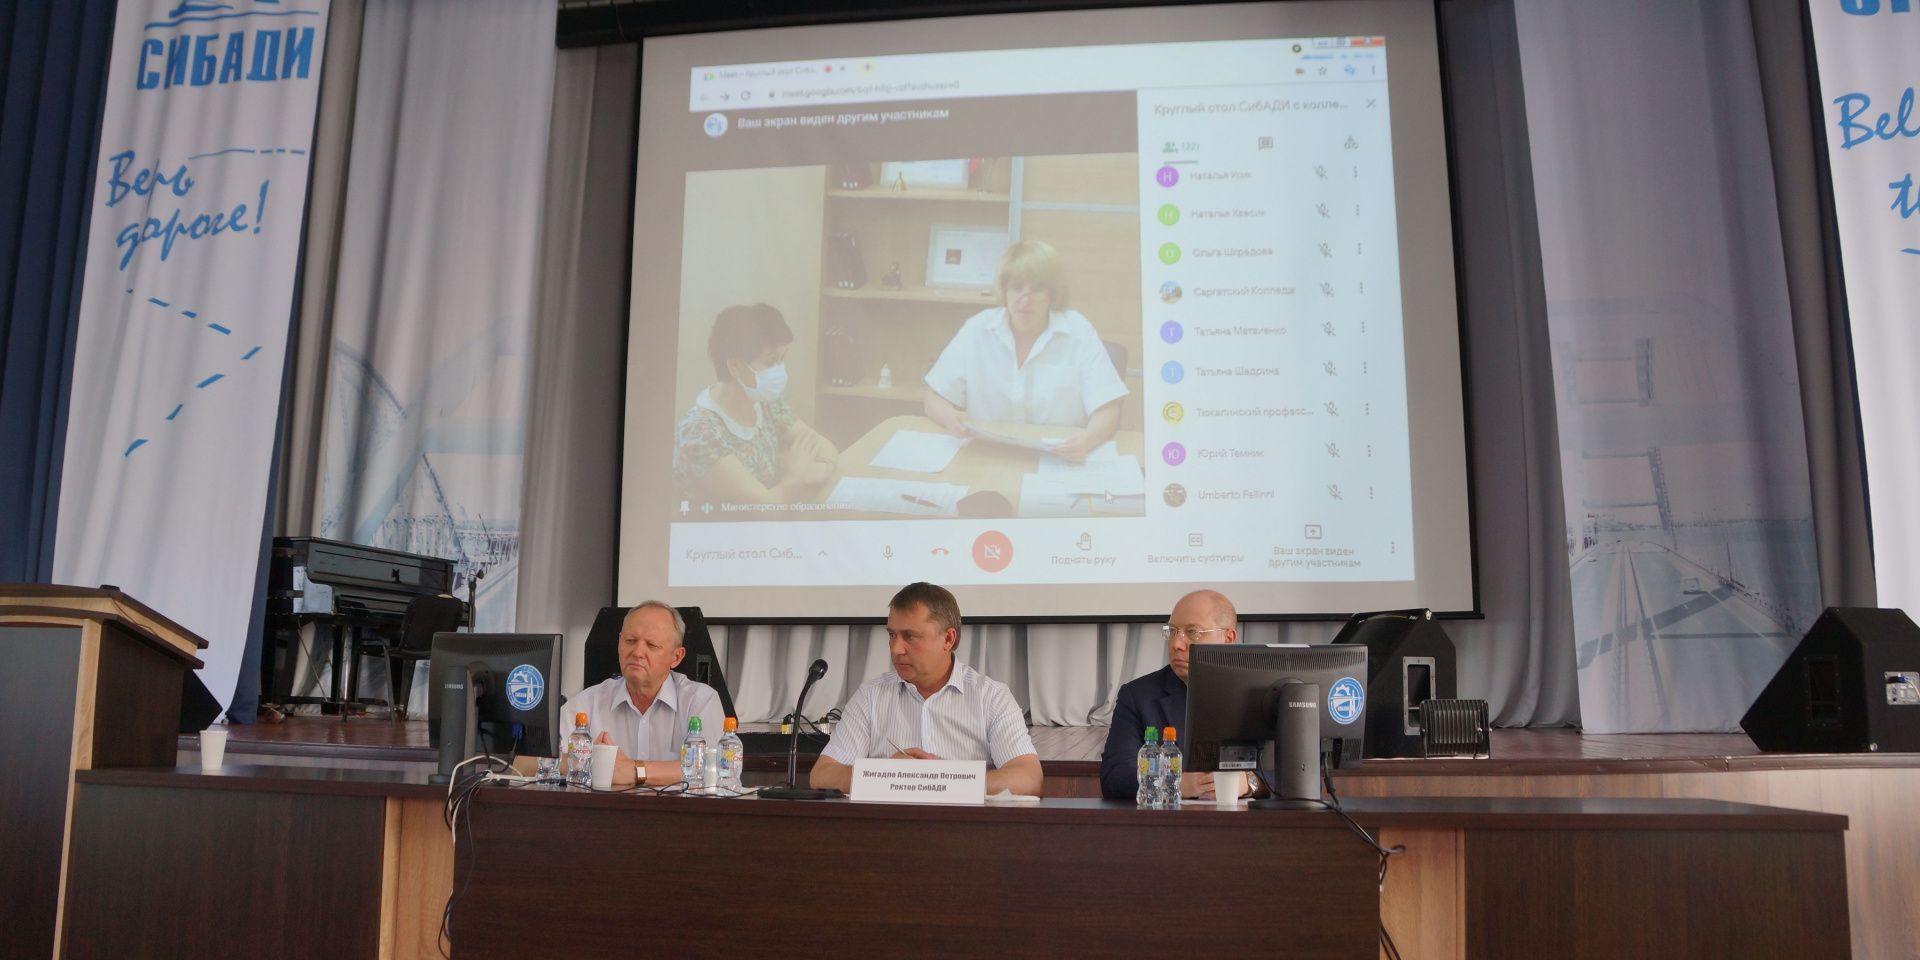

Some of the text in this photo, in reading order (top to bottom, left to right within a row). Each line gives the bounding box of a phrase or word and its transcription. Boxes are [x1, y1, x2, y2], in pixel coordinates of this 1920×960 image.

[137, 27, 315, 90] СИБАДИ
[1153, 103, 1205, 117] Круглый
[1208, 103, 1237, 114] стол
[1238, 99, 1291, 113] СибАДИ
[738, 117, 762, 130] Ваш
[800, 114, 834, 127] виден
[837, 112, 878, 129] другим
[880, 108, 949, 128] участникам
[105, 150, 194, 212] Верь
[116, 179, 269, 271] дороге!
[721, 502, 788, 513] Министерство
[686, 549, 735, 562] Круглый
[738, 550, 766, 560] стол
[1274, 546, 1355, 558] Ваш экран виден
[1051, 555, 1117, 567] Поднять руку
[1148, 553, 1244, 565] Включить субтитры
[1268, 558, 1361, 570] другим участникам
[863, 770, 976, 780] Жигадло Александр Петрович
[890, 783, 947, 792] Ректор СибАДИ
